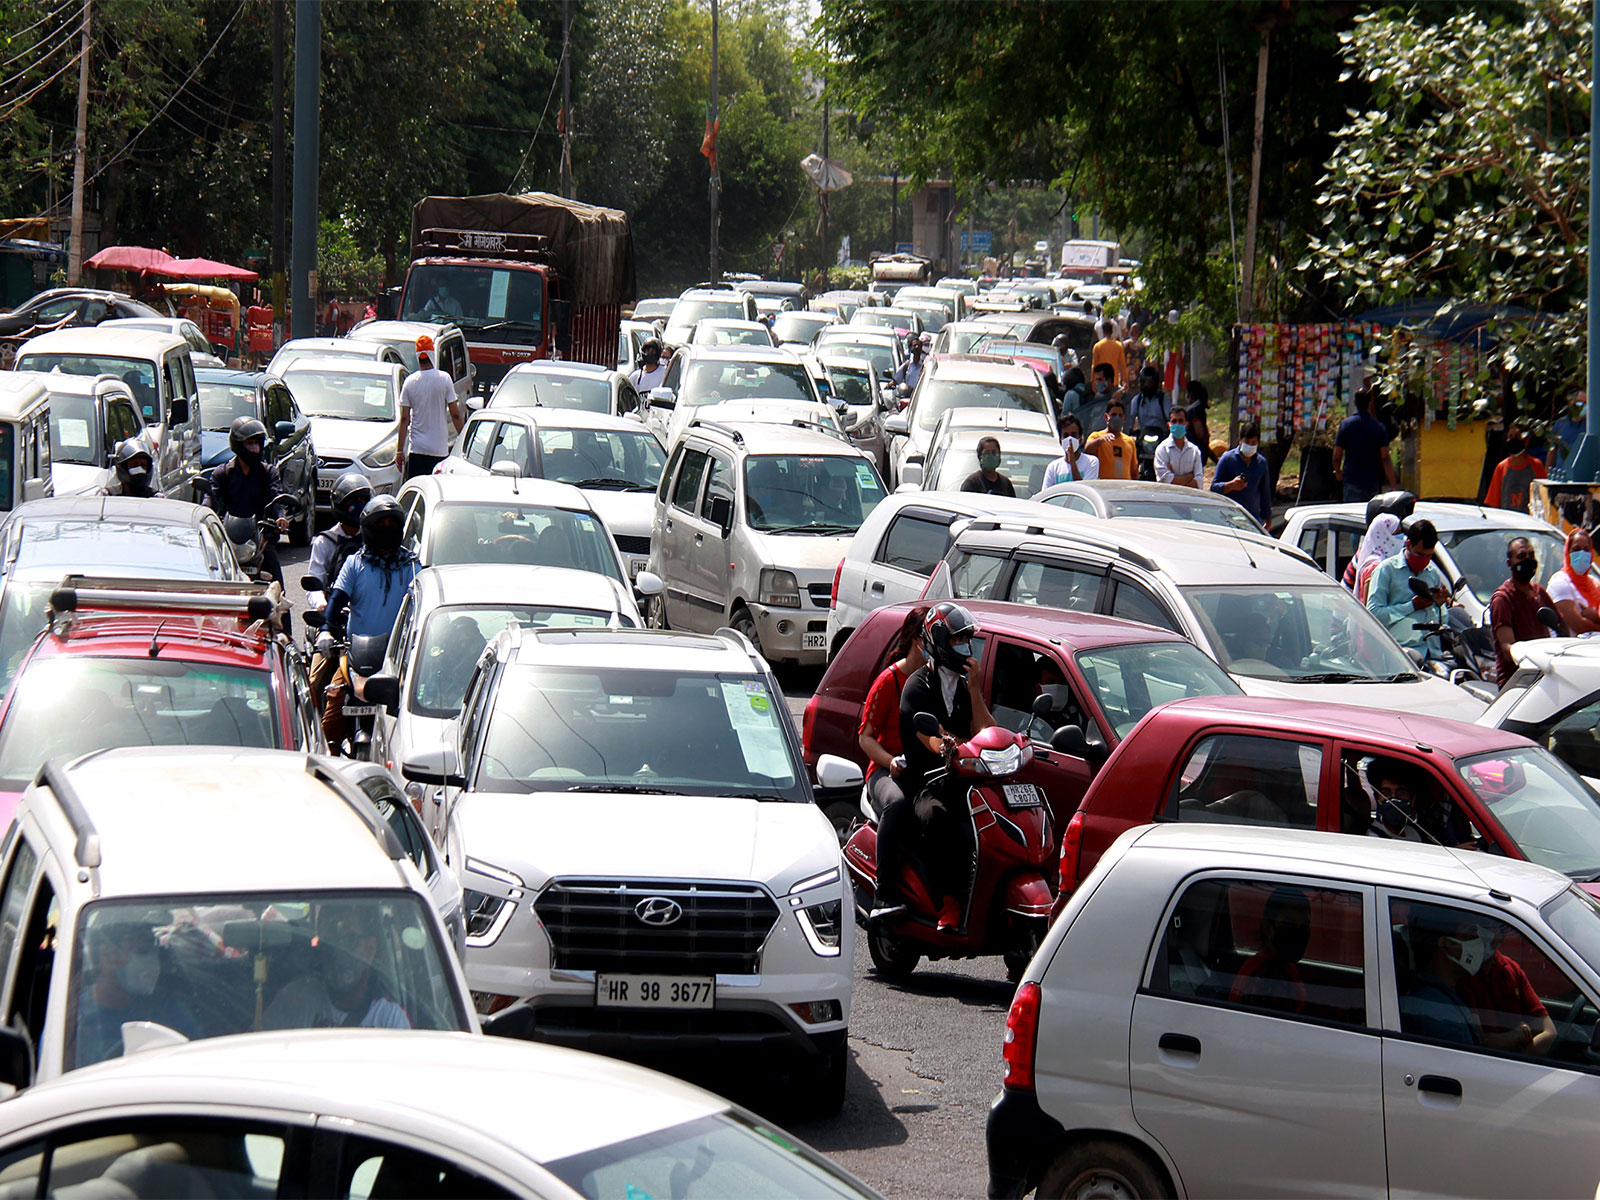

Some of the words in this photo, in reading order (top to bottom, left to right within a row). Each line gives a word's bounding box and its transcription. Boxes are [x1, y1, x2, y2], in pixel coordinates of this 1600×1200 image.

[807, 635, 827, 647] HR2
[609, 980, 629, 1001] HR
[640, 982, 660, 1001] 98
[670, 983, 711, 1003] 3677
